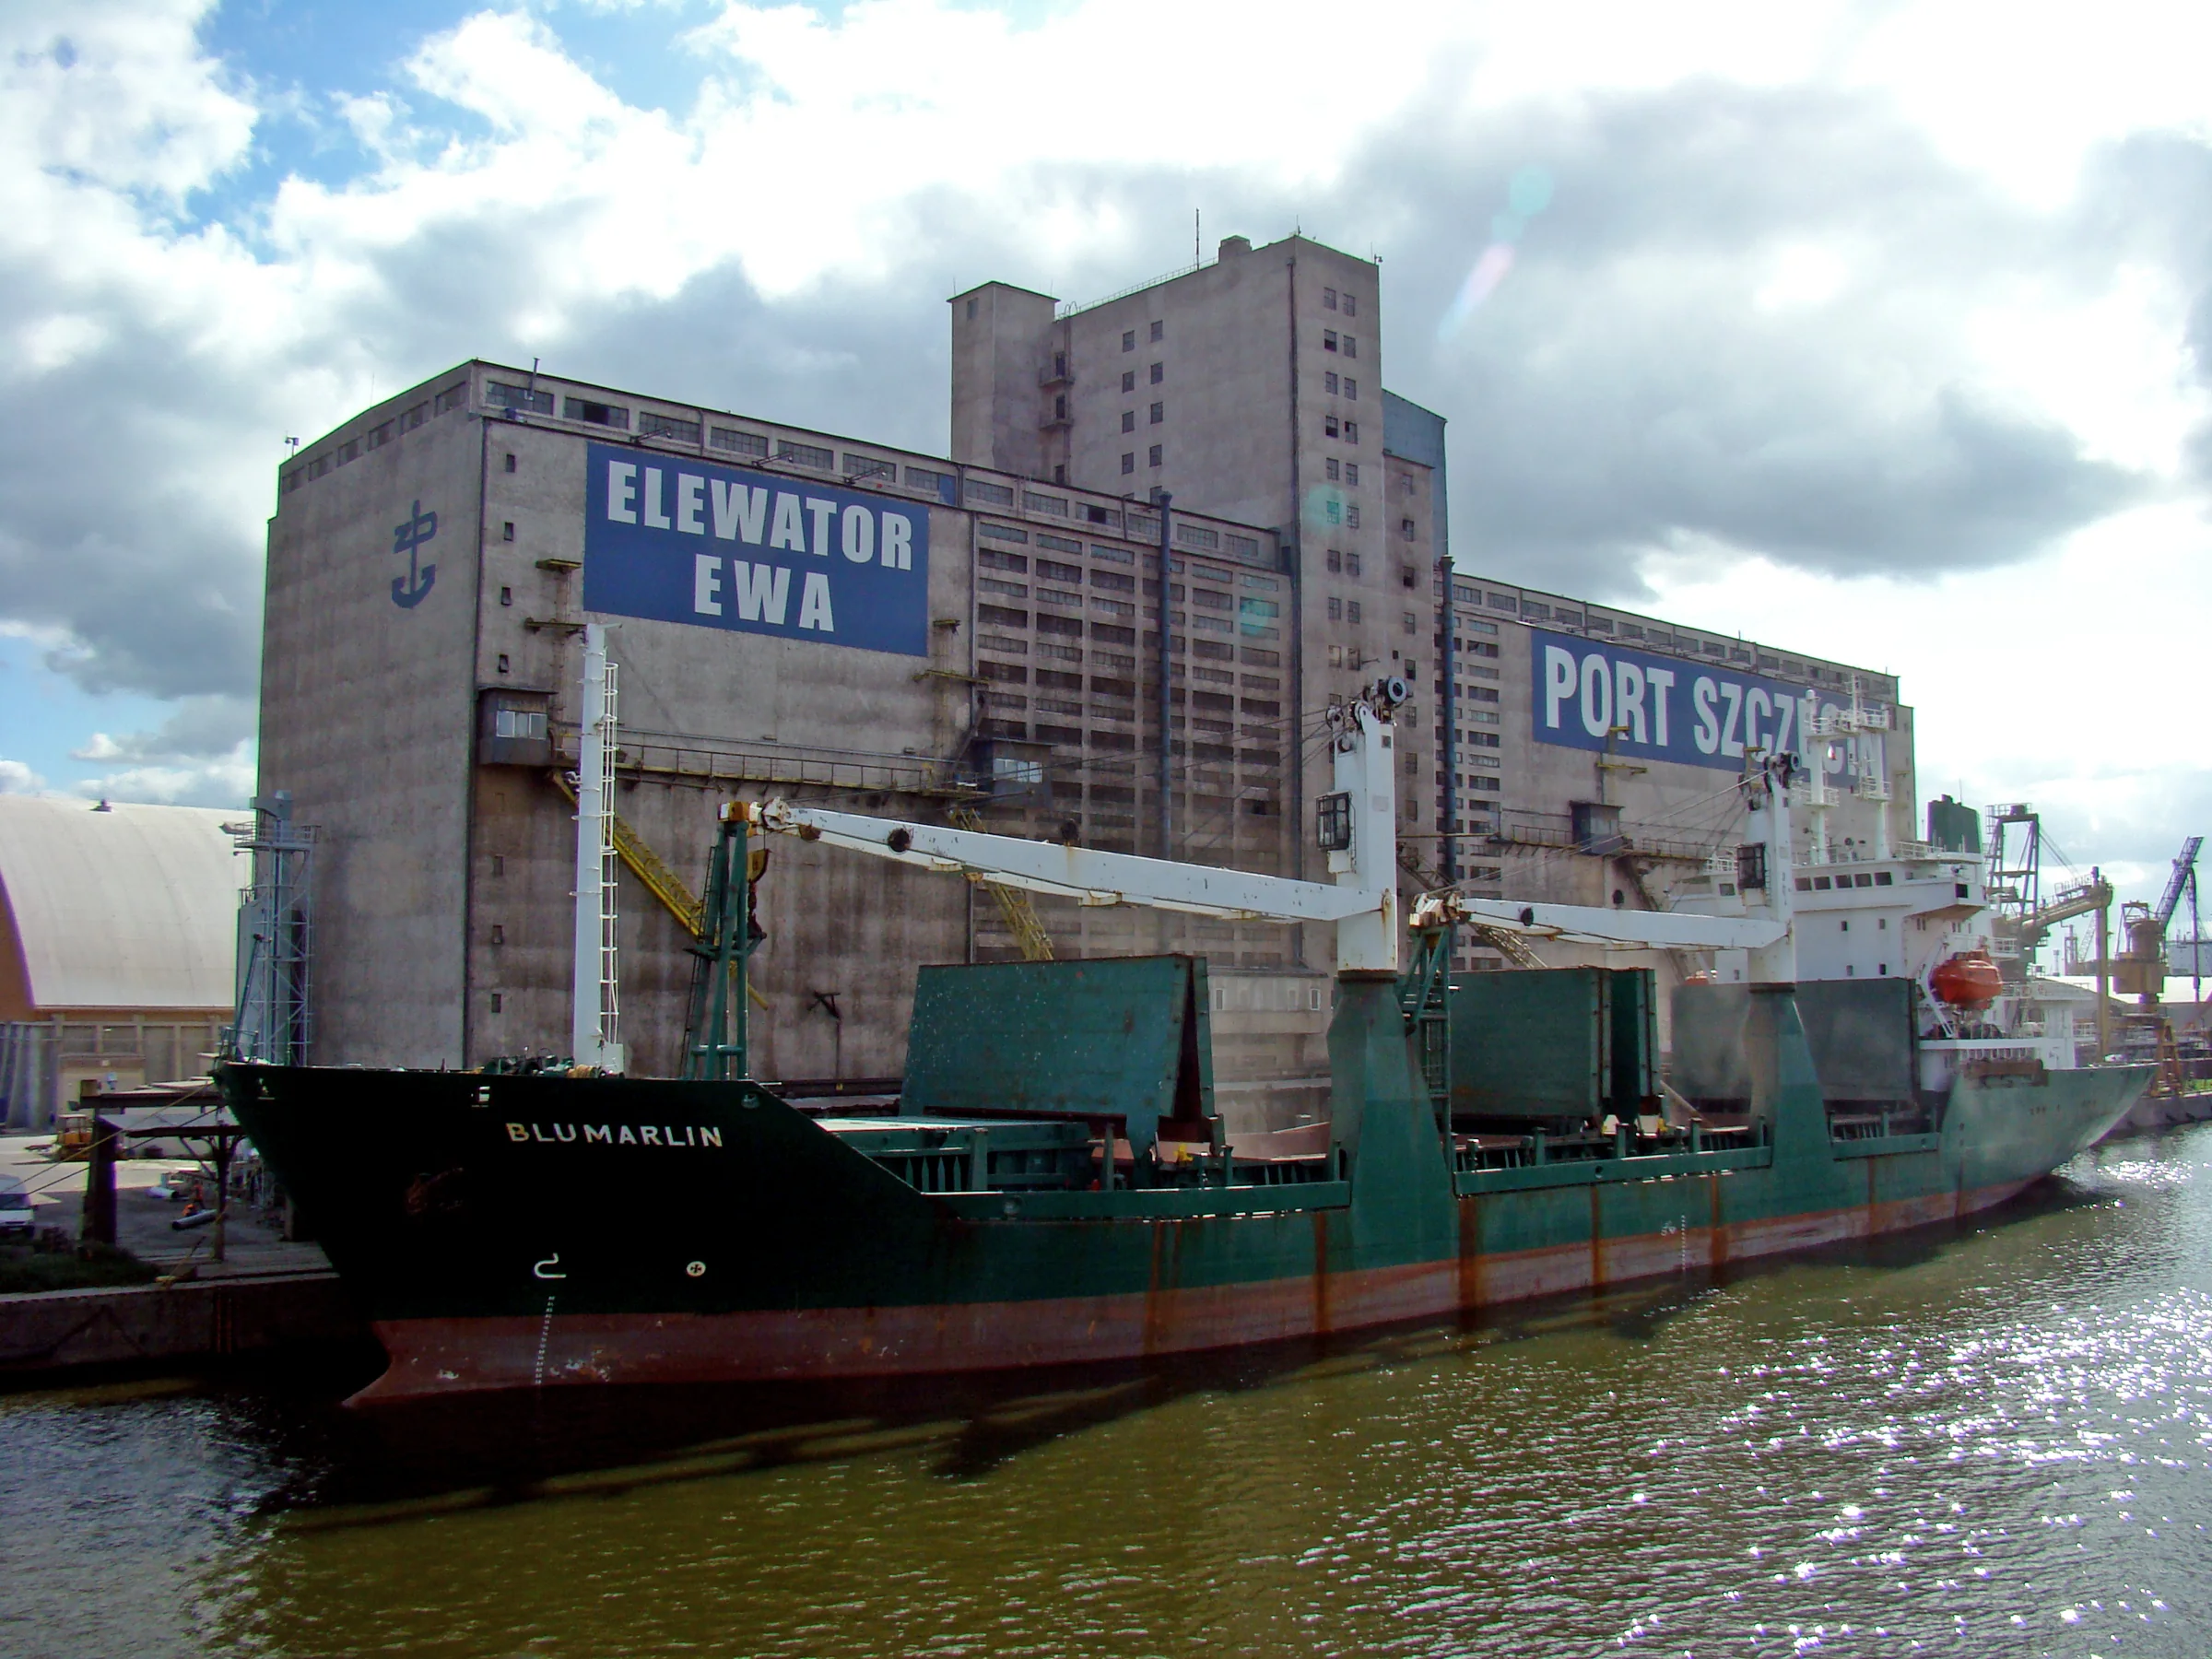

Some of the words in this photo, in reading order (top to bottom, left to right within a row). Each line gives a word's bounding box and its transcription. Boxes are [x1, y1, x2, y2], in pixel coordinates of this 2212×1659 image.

[607, 460, 912, 571] ELEWATOR
[695, 554, 834, 632] EWA
[1545, 644, 1675, 747] PORT
[505, 1122, 723, 1147] BLUMARLIN
